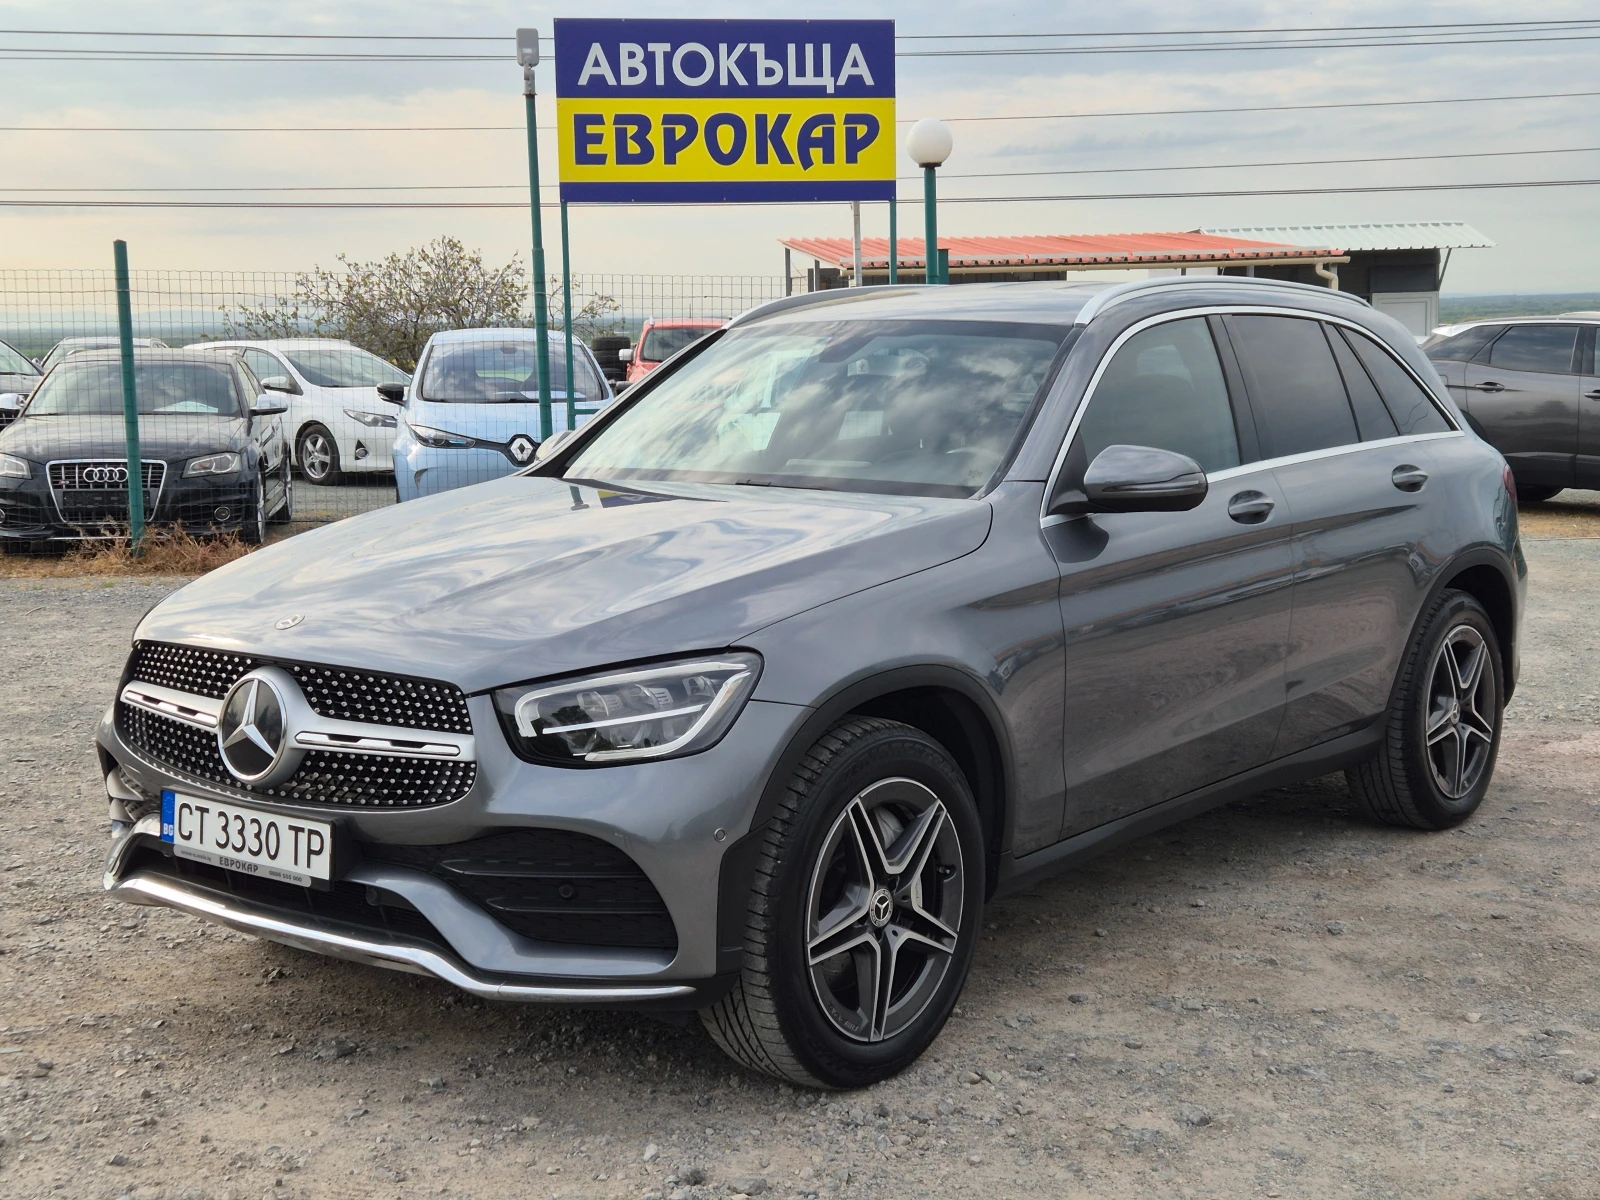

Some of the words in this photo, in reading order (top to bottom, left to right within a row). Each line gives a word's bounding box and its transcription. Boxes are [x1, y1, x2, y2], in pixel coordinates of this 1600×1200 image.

[577, 41, 875, 94] АВТОКЪЩА
[572, 111, 881, 172] ЕВРОКАР
[163, 823, 174, 837] BG
[178, 802, 209, 845] CT
[215, 810, 280, 861] 3330
[288, 824, 325, 869] TP
[219, 856, 259, 873] ЕВРОКАР
